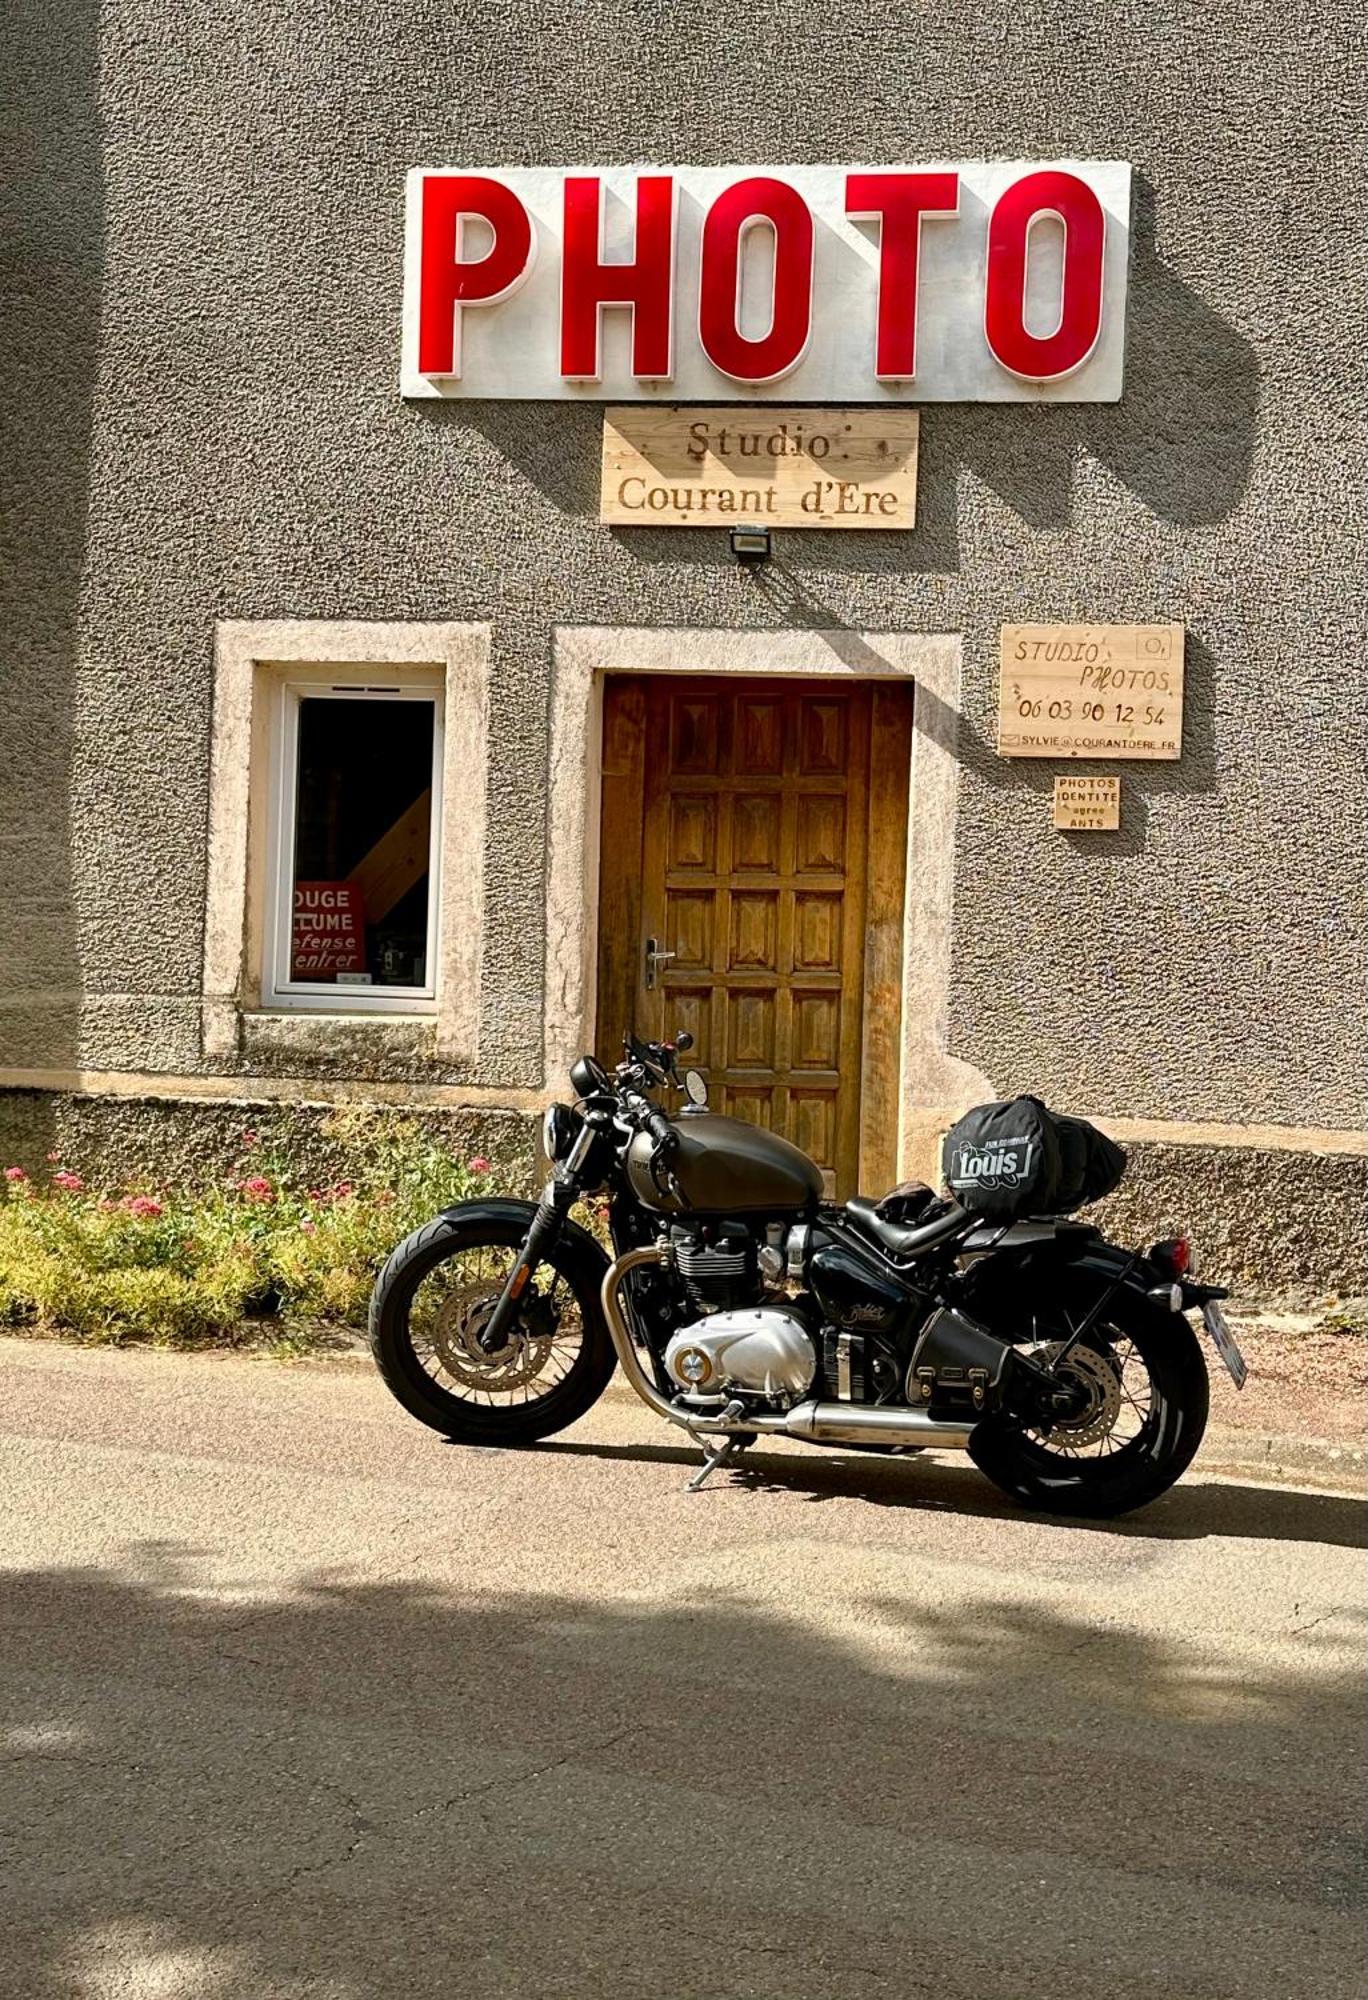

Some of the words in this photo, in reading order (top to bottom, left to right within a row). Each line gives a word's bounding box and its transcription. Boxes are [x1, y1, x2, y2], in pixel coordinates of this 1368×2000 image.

[418, 171, 1107, 383] PHOTO
[687, 423, 831, 459] Studio
[618, 477, 778, 513] Courant
[801, 481, 899, 516] d'Ere
[1014, 641, 1099, 663] STUDIO
[1080, 666, 1171, 692] PHOTOS
[1019, 699, 1042, 718] 06
[1049, 701, 1072, 720] 03
[1081, 702, 1104, 721] 90
[1116, 704, 1134, 723] 12
[1143, 706, 1165, 725] 54
[1060, 779, 1116, 788] PHOTOS
[1056, 792, 1118, 802] IDENTITE
[1070, 819, 1104, 827] ANTS
[960, 1148, 1018, 1178] Louis
